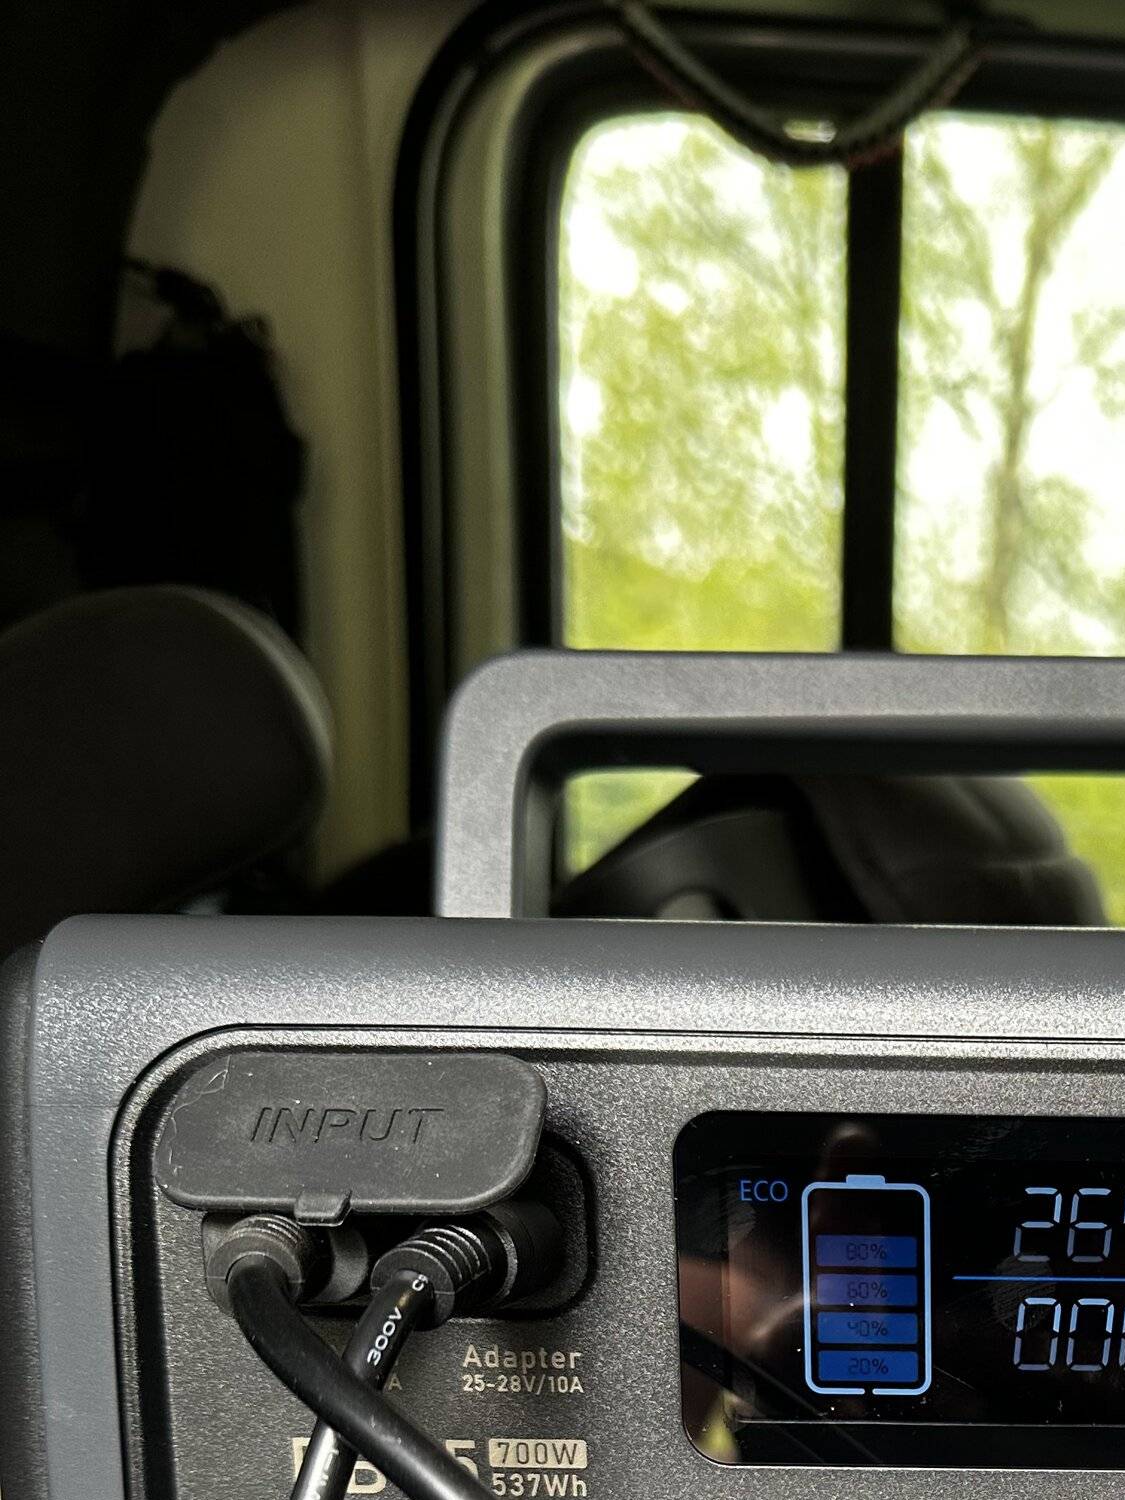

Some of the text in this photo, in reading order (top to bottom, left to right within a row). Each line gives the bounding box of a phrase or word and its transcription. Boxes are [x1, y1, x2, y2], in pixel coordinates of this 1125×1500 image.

[249, 1105, 445, 1144] INPUT
[740, 1180, 789, 1202] ECO
[846, 1243, 887, 1261] 80%
[846, 1281, 888, 1299] 60%
[366, 1305, 404, 1367] 300V
[847, 1319, 889, 1338] 40%
[462, 1343, 582, 1375] Adapter
[848, 1357, 889, 1376] 20%
[462, 1374, 584, 1396] 25-28V/10A
[497, 1442, 578, 1465] 700W
[491, 1473, 587, 1497] 537Wh
